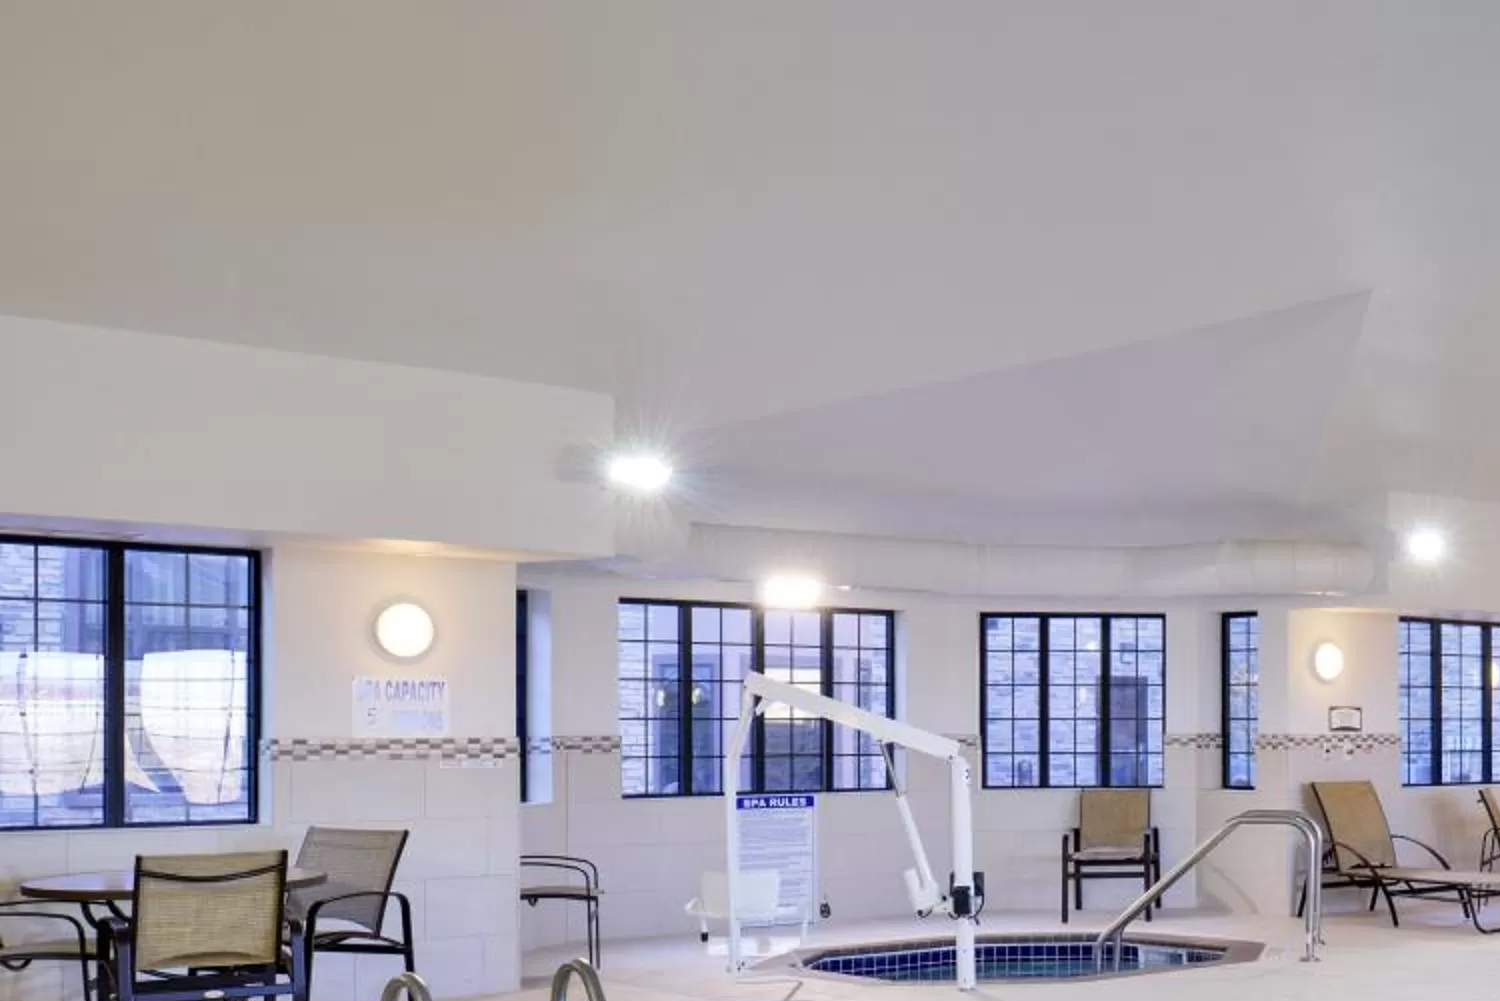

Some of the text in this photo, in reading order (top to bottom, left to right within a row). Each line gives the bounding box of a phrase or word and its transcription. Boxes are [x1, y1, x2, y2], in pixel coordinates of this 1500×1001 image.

[385, 680, 445, 701] CAPACITY
[742, 796, 807, 808] SPA RULES
